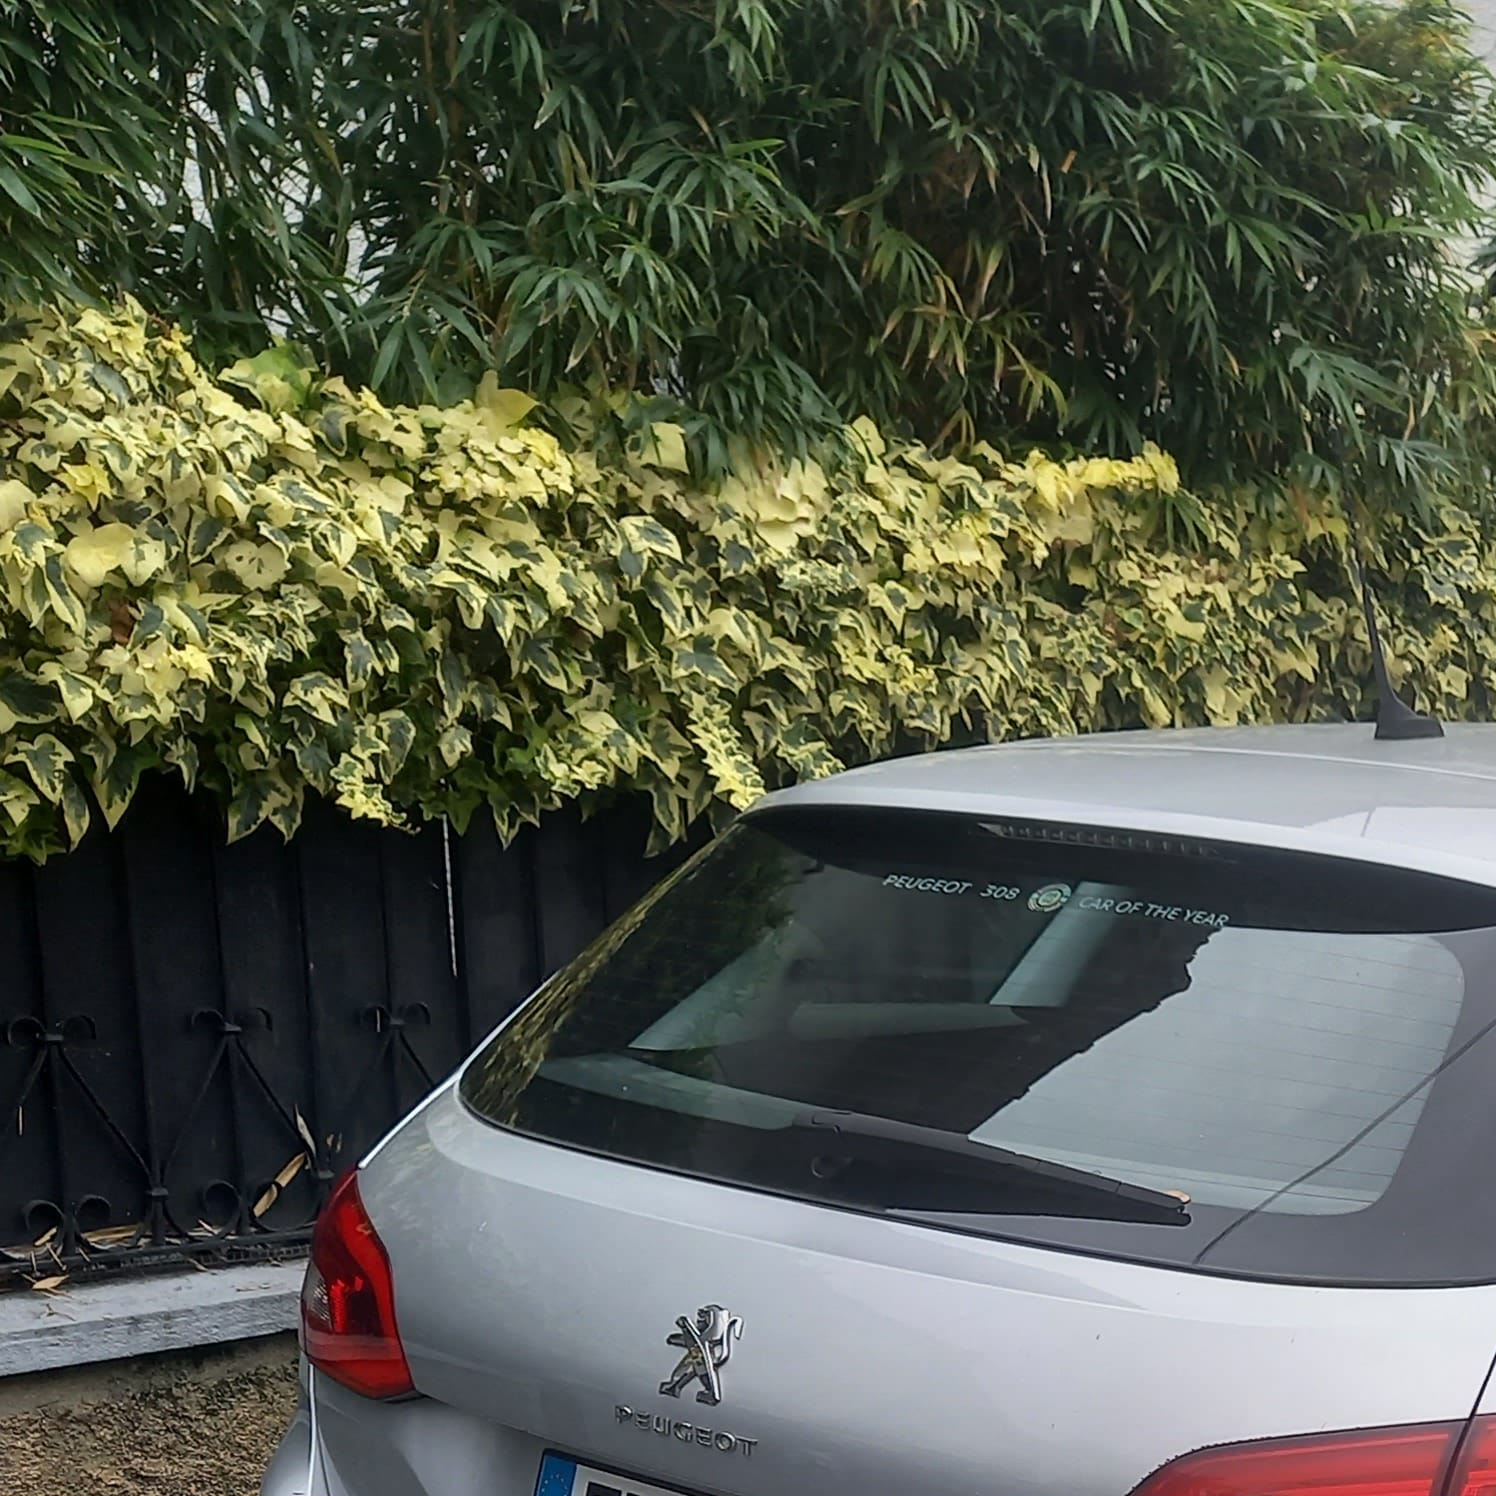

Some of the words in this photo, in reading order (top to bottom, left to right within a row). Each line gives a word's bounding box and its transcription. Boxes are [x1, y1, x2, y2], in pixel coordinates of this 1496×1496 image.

[882, 874, 973, 895] PEUGEOT
[979, 884, 1021, 900] 308
[1079, 896, 1115, 911] CAR
[1115, 901, 1144, 914] OF
[1144, 903, 1182, 920] THE
[1183, 909, 1230, 927] YEAR
[614, 1404, 759, 1456] PEUGEOT
